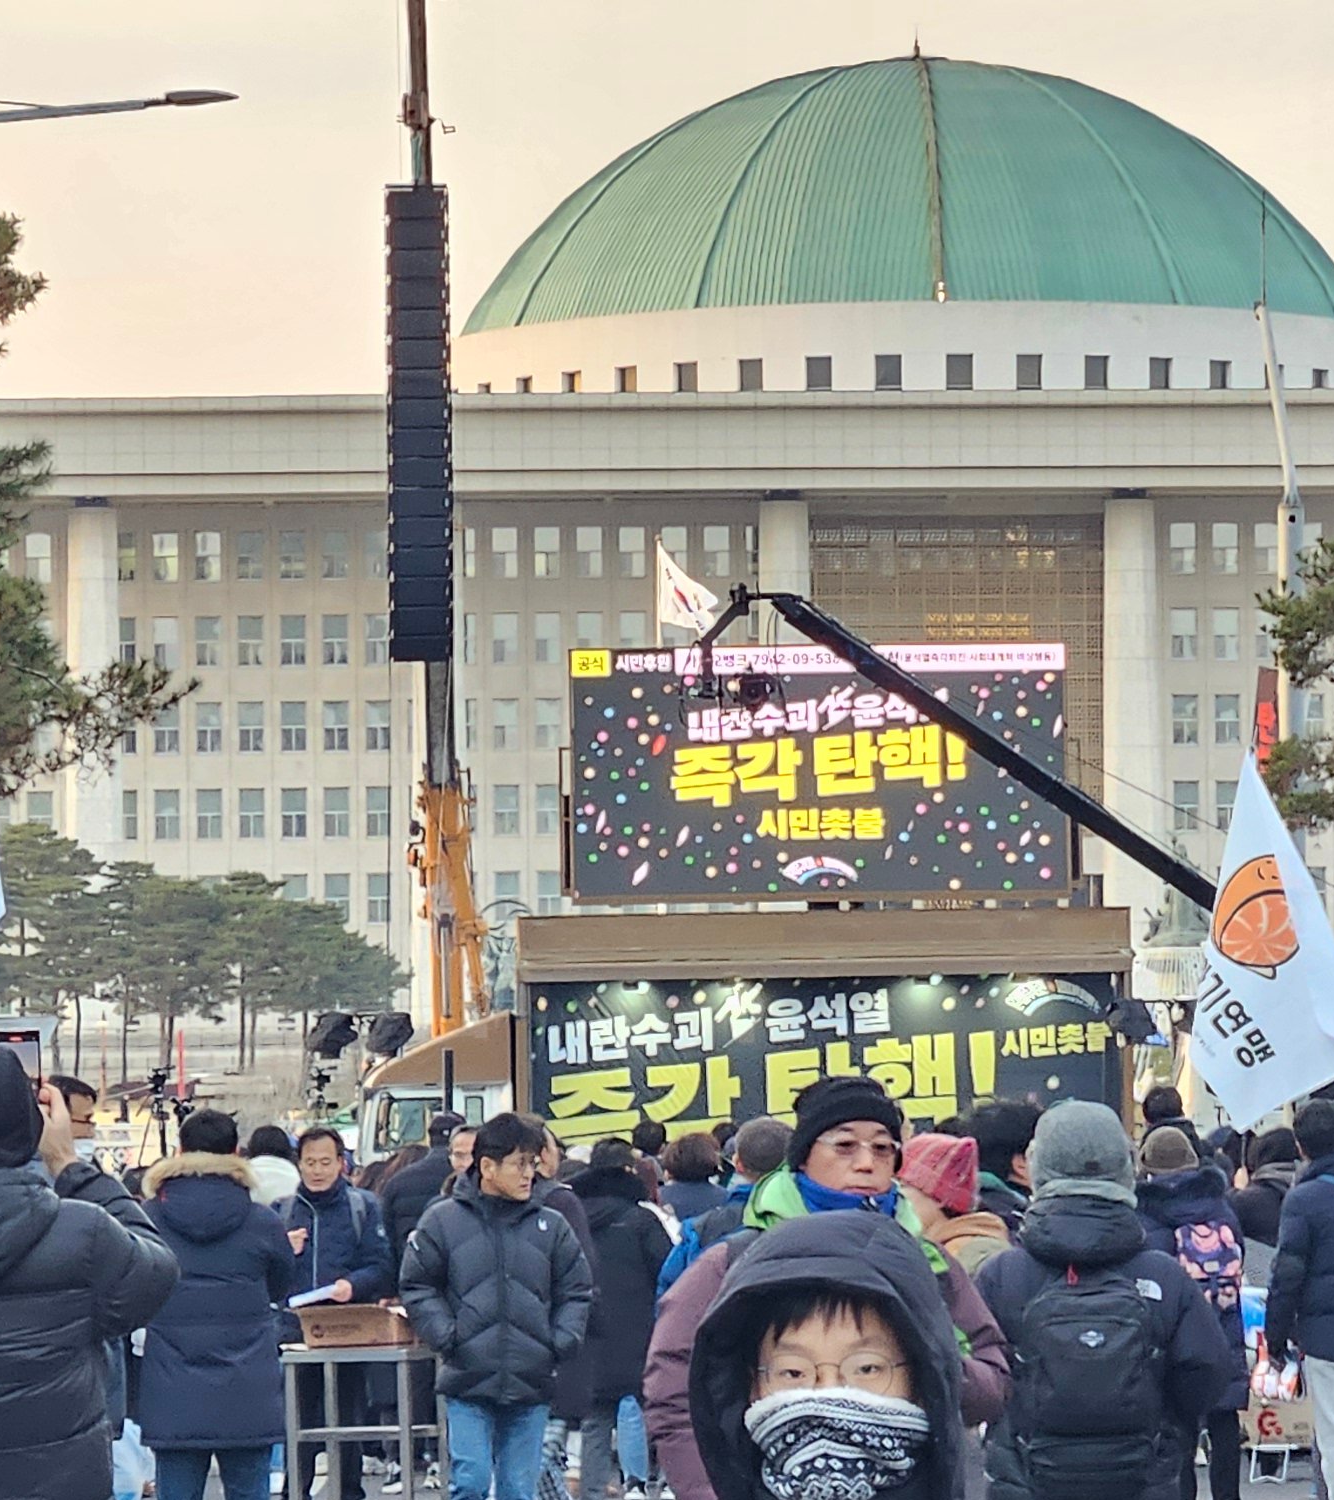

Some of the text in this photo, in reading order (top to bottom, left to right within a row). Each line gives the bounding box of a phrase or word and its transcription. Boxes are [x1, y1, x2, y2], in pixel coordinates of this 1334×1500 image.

[577, 655, 605, 672] 공식
[615, 653, 673, 673] 시민후원
[670, 723, 968, 807] 즉각 탄핵!
[756, 807, 886, 841] 시민촛불
[547, 988, 892, 1065] 내란수괴 윤석열
[1197, 965, 1276, 1069] 기연맹
[1000, 1020, 1113, 1059] 시민촛불
